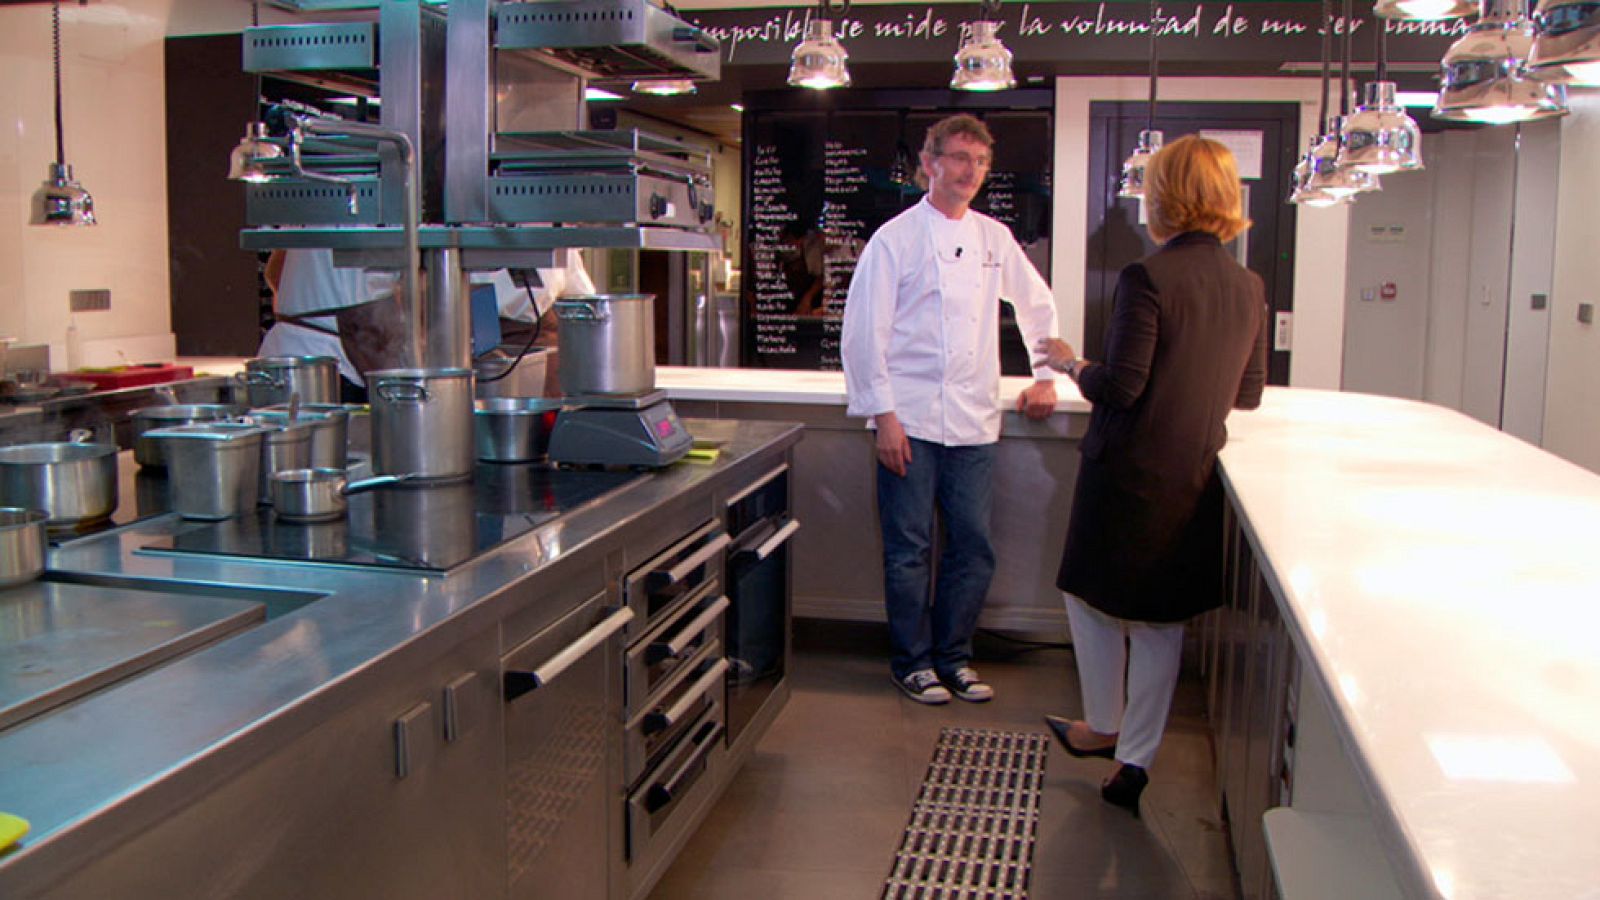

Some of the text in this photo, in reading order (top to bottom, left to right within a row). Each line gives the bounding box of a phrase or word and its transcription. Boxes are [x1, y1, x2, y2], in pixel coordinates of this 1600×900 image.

[835, 18, 863, 39] se
[874, 7, 947, 40] mide
[957, 20, 1006, 51] pr
[1018, 4, 1052, 37] la
[1060, 2, 1202, 38] voluntad
[1213, 4, 1249, 38] de
[1261, 18, 1307, 35] un
